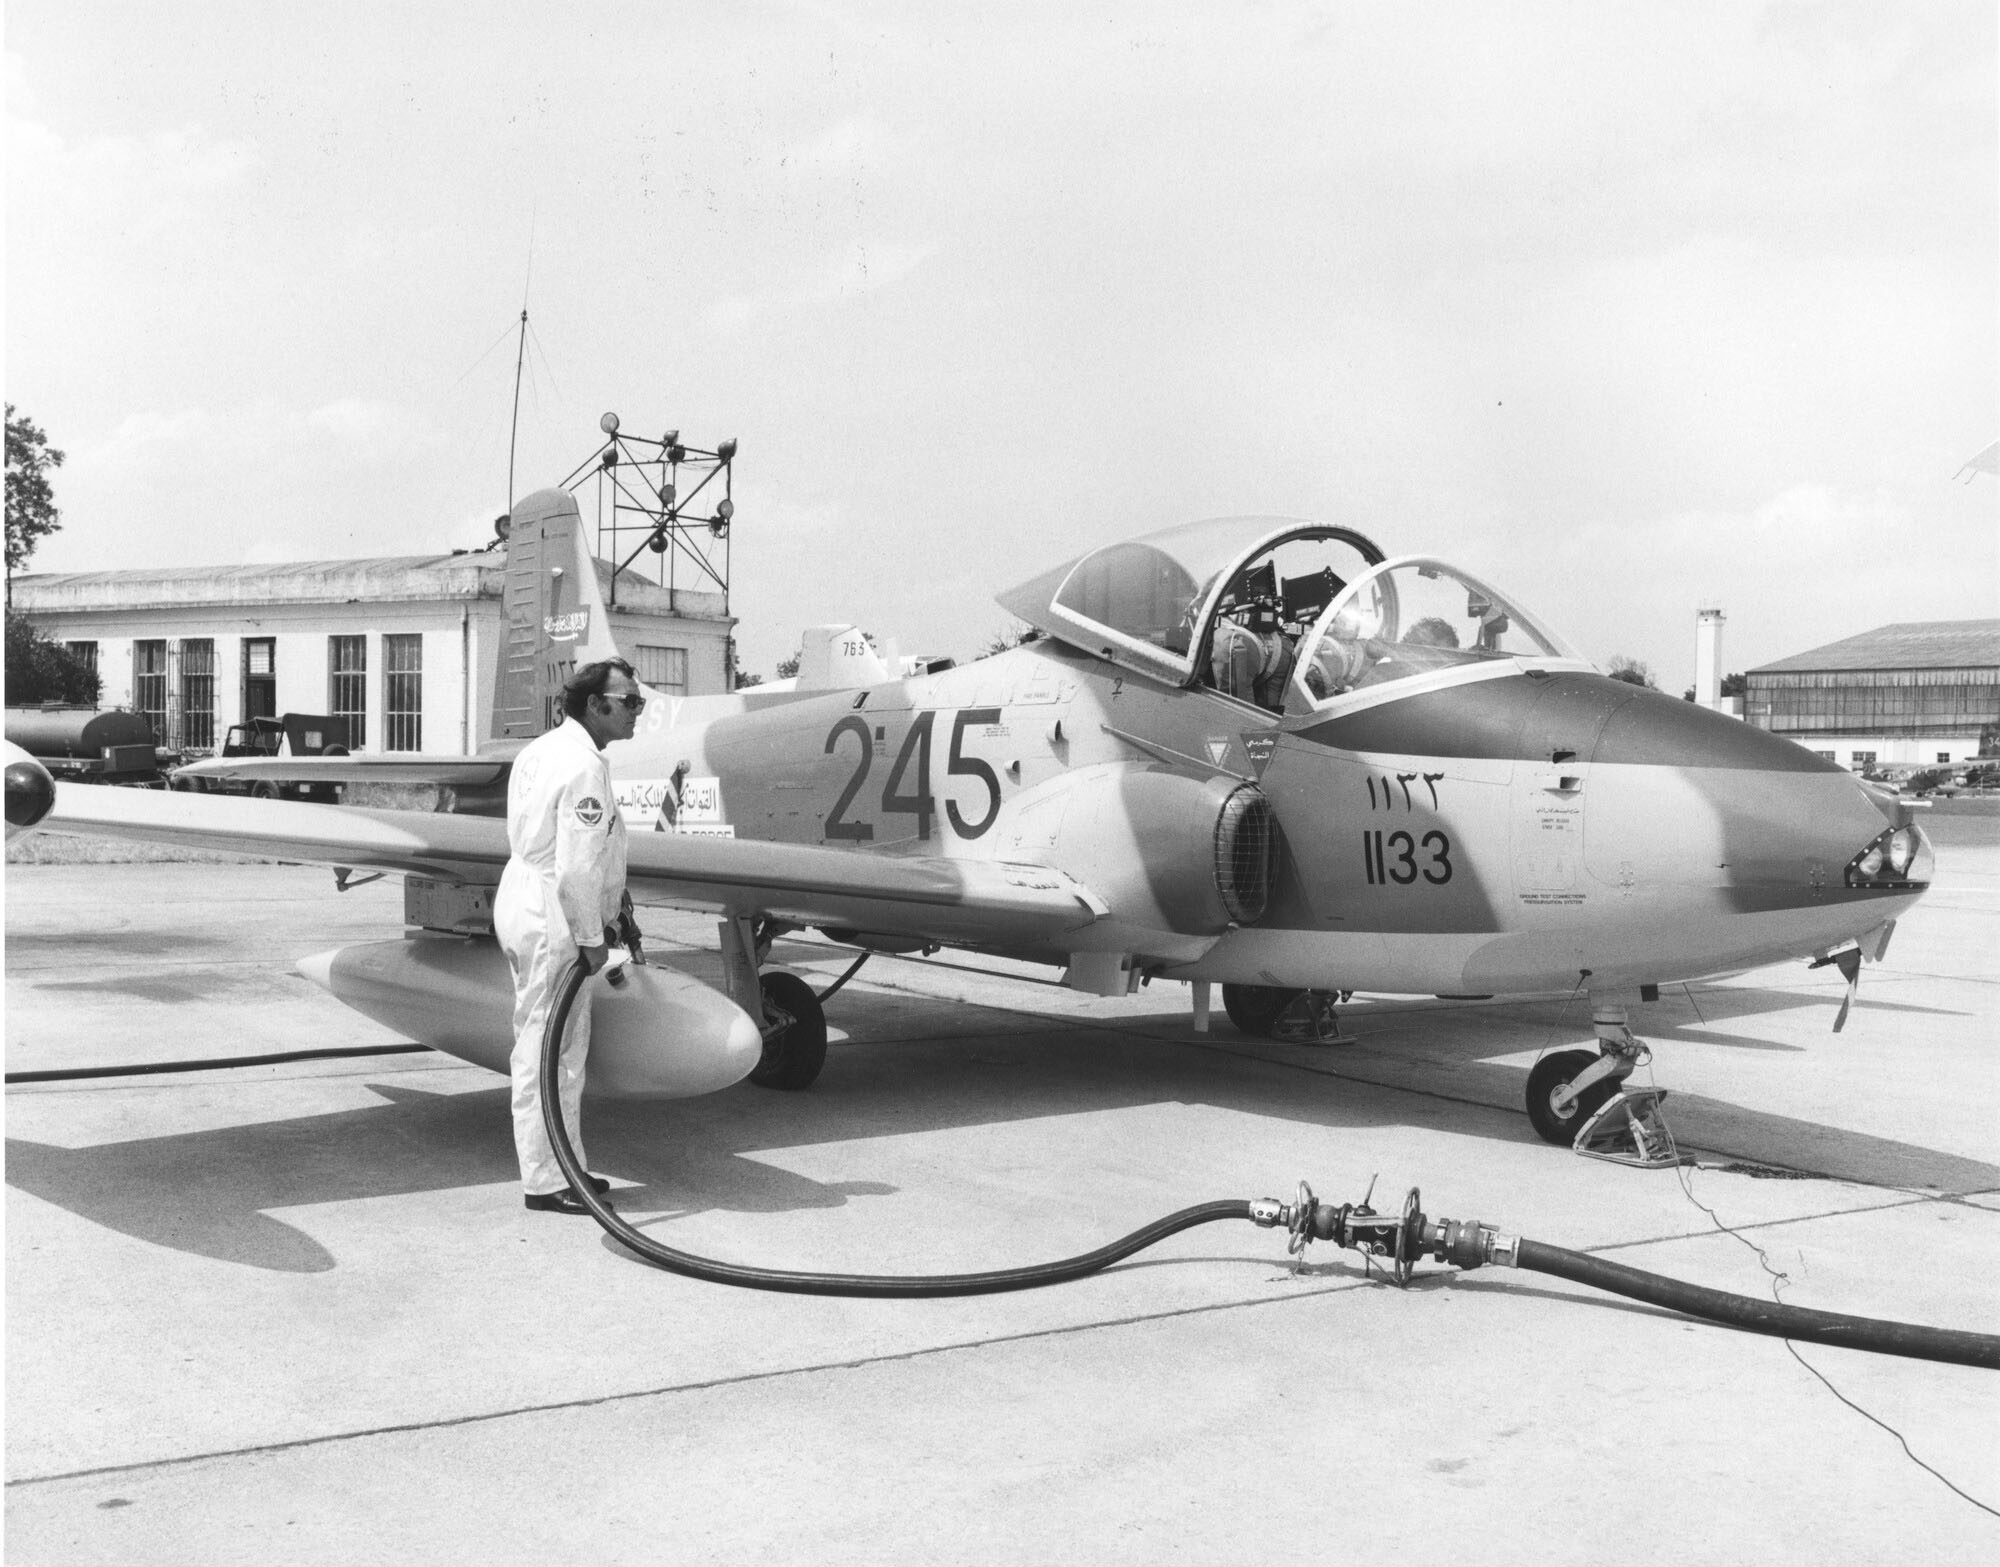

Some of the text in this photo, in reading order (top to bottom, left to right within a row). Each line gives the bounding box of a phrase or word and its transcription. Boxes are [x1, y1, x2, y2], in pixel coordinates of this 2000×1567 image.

[843, 642, 865, 656] 763
[824, 708, 1002, 840] 245
[1364, 830, 1452, 885] 1133
